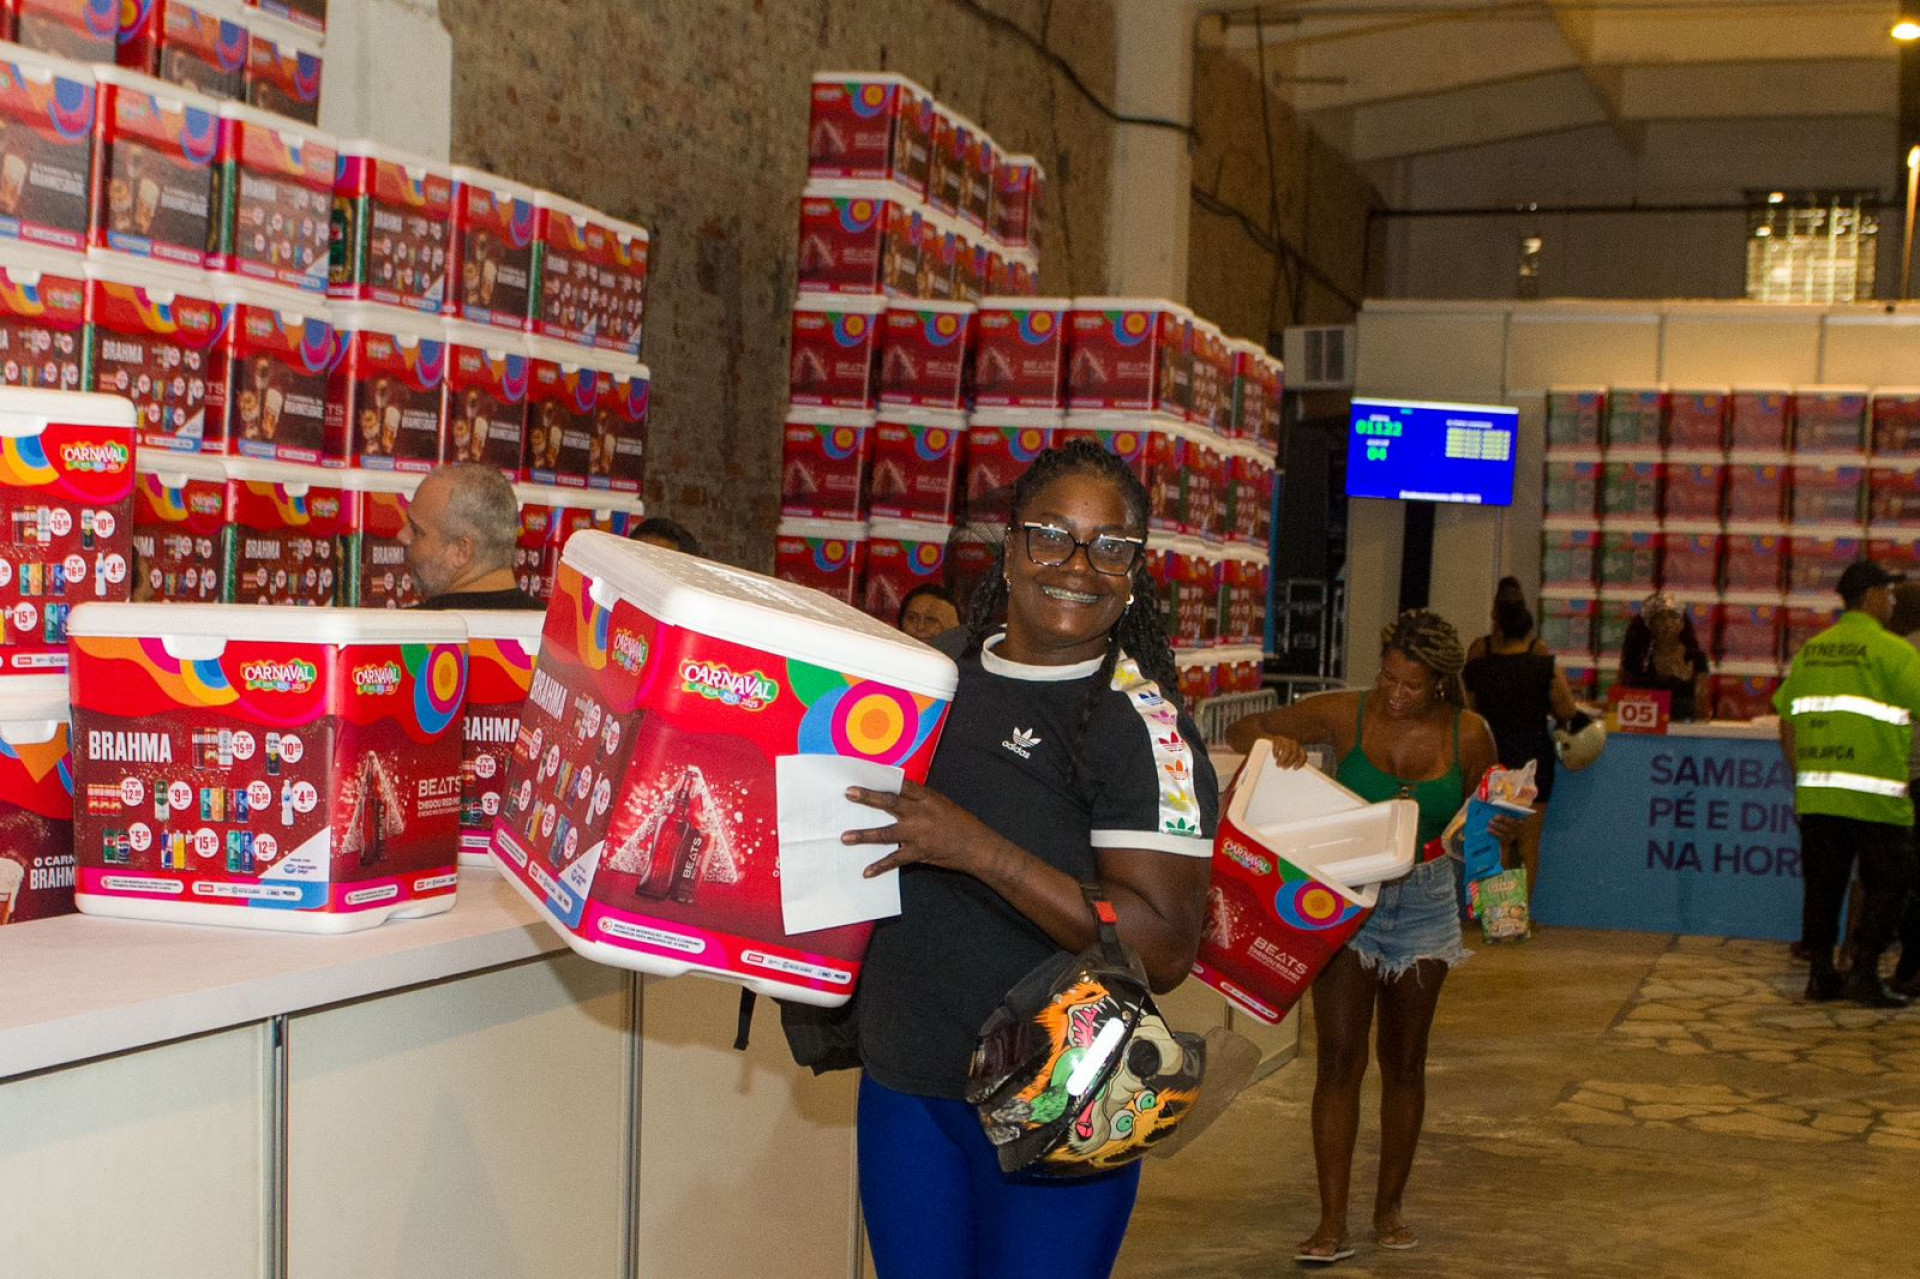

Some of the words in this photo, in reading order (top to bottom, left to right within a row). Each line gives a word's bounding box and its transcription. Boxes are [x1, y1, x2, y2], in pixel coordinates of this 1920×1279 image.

[65, 446, 125, 462] CARNAVAL
[245, 665, 313, 682] CARNAVAL
[684, 664, 774, 700] CARNAVAL
[1622, 704, 1653, 722] 05
[89, 731, 172, 762] BRAHMA
[1002, 741, 1031, 759] adidas
[419, 776, 461, 797] BEATS
[1651, 754, 1796, 791] SAMBA
[1650, 791, 1695, 829] PÉ
[1707, 802, 1729, 830] E
[683, 837, 703, 878] BEATS
[1646, 840, 1702, 871] NA
[1254, 936, 1308, 975] BEATS
